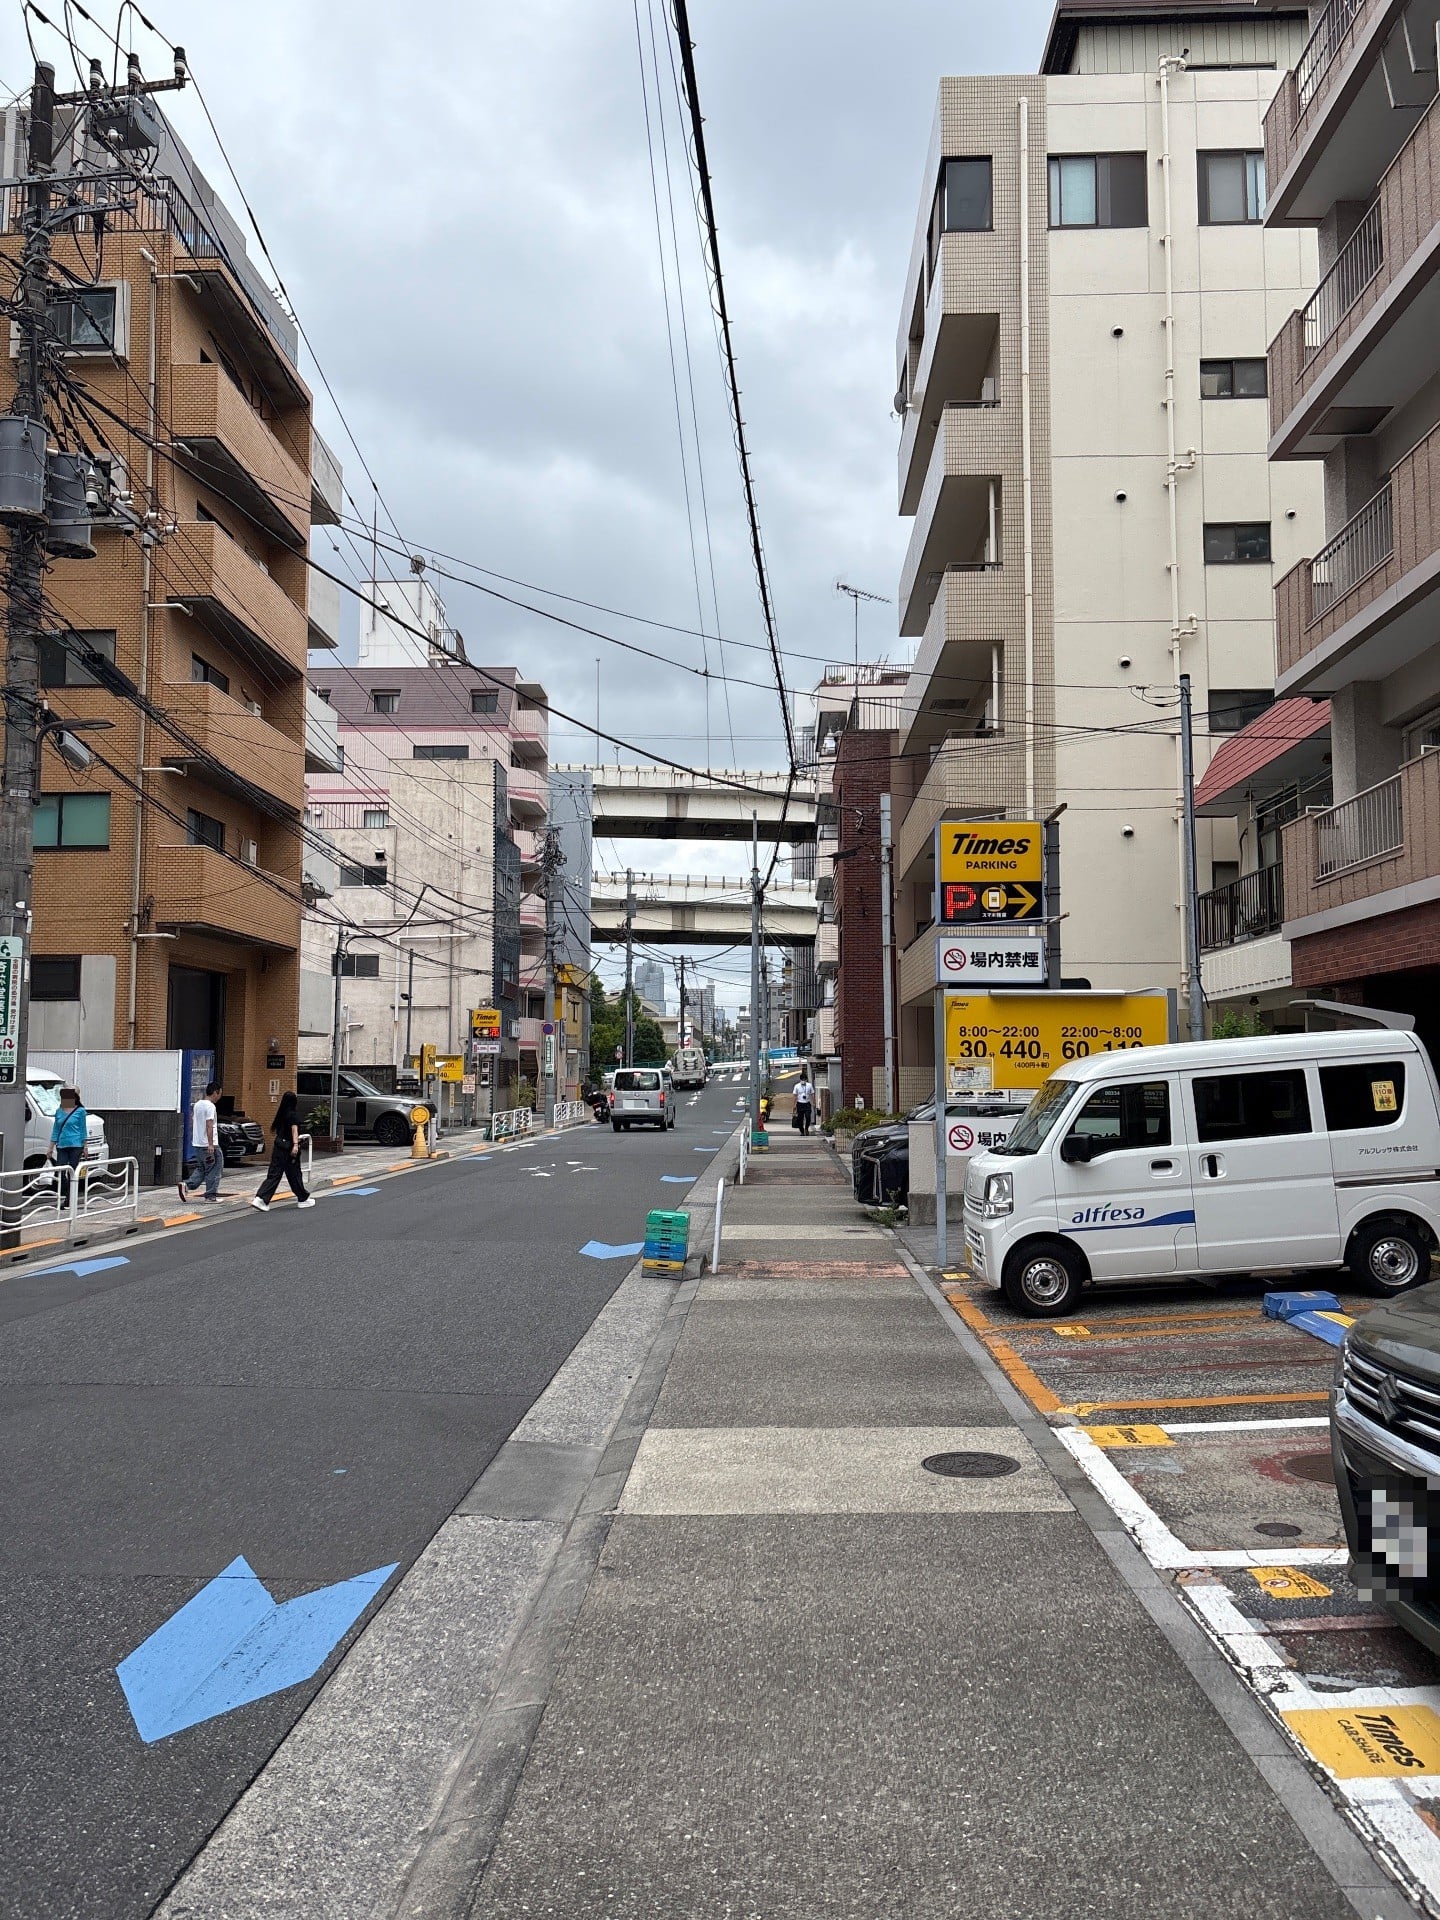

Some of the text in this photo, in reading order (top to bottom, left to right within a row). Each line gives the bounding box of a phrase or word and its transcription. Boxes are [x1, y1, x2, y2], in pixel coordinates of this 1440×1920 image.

[952, 834, 1031, 855] Times
[966, 861, 1017, 870] PARKING
[946, 885, 976, 919] P
[970, 952, 1039, 968] 場内禁煙
[1062, 1041, 1090, 1059] 60
[1358, 1145, 1419, 1155] アルフレッサ株式会社
[1072, 1202, 1145, 1224] alfresa
[1354, 1714, 1426, 1769] Times
